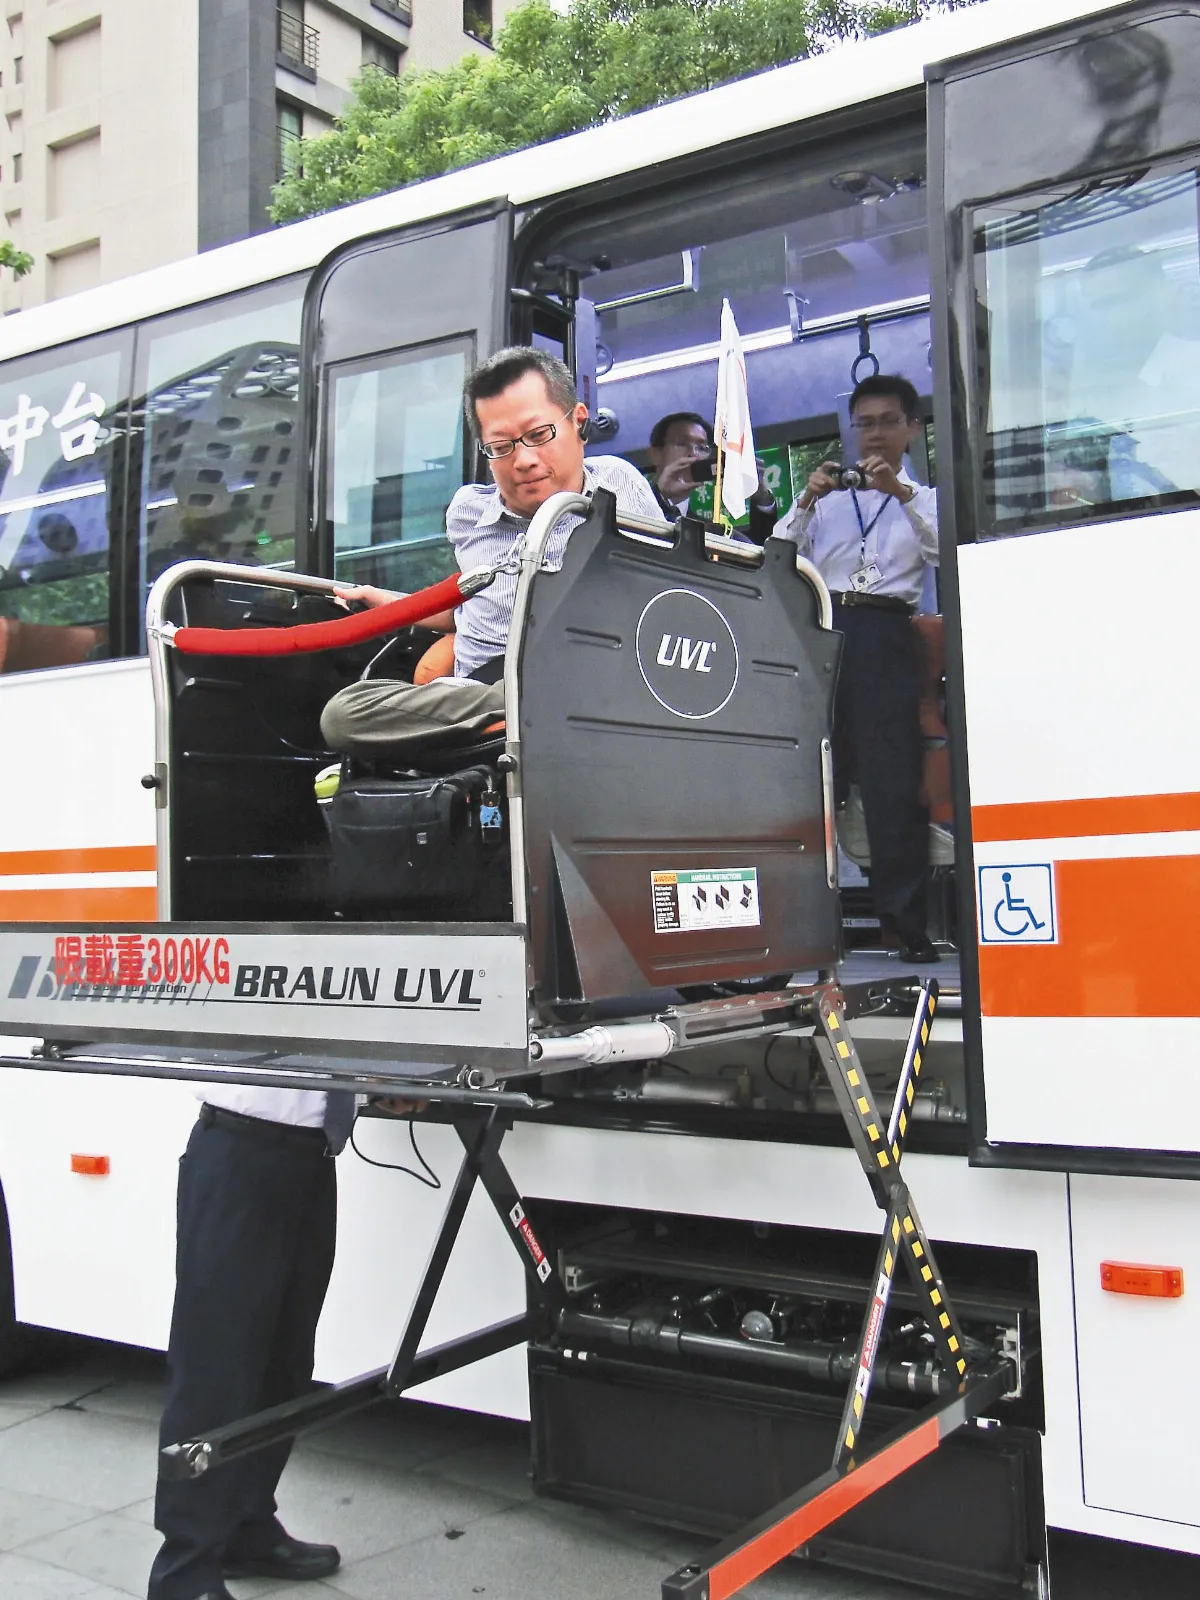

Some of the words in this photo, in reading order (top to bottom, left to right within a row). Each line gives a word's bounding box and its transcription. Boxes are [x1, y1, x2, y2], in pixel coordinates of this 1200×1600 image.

[234, 964, 379, 1001] BRAUN
[525, 1230, 543, 1259] DANGER
[865, 1304, 880, 1349] DANGER
